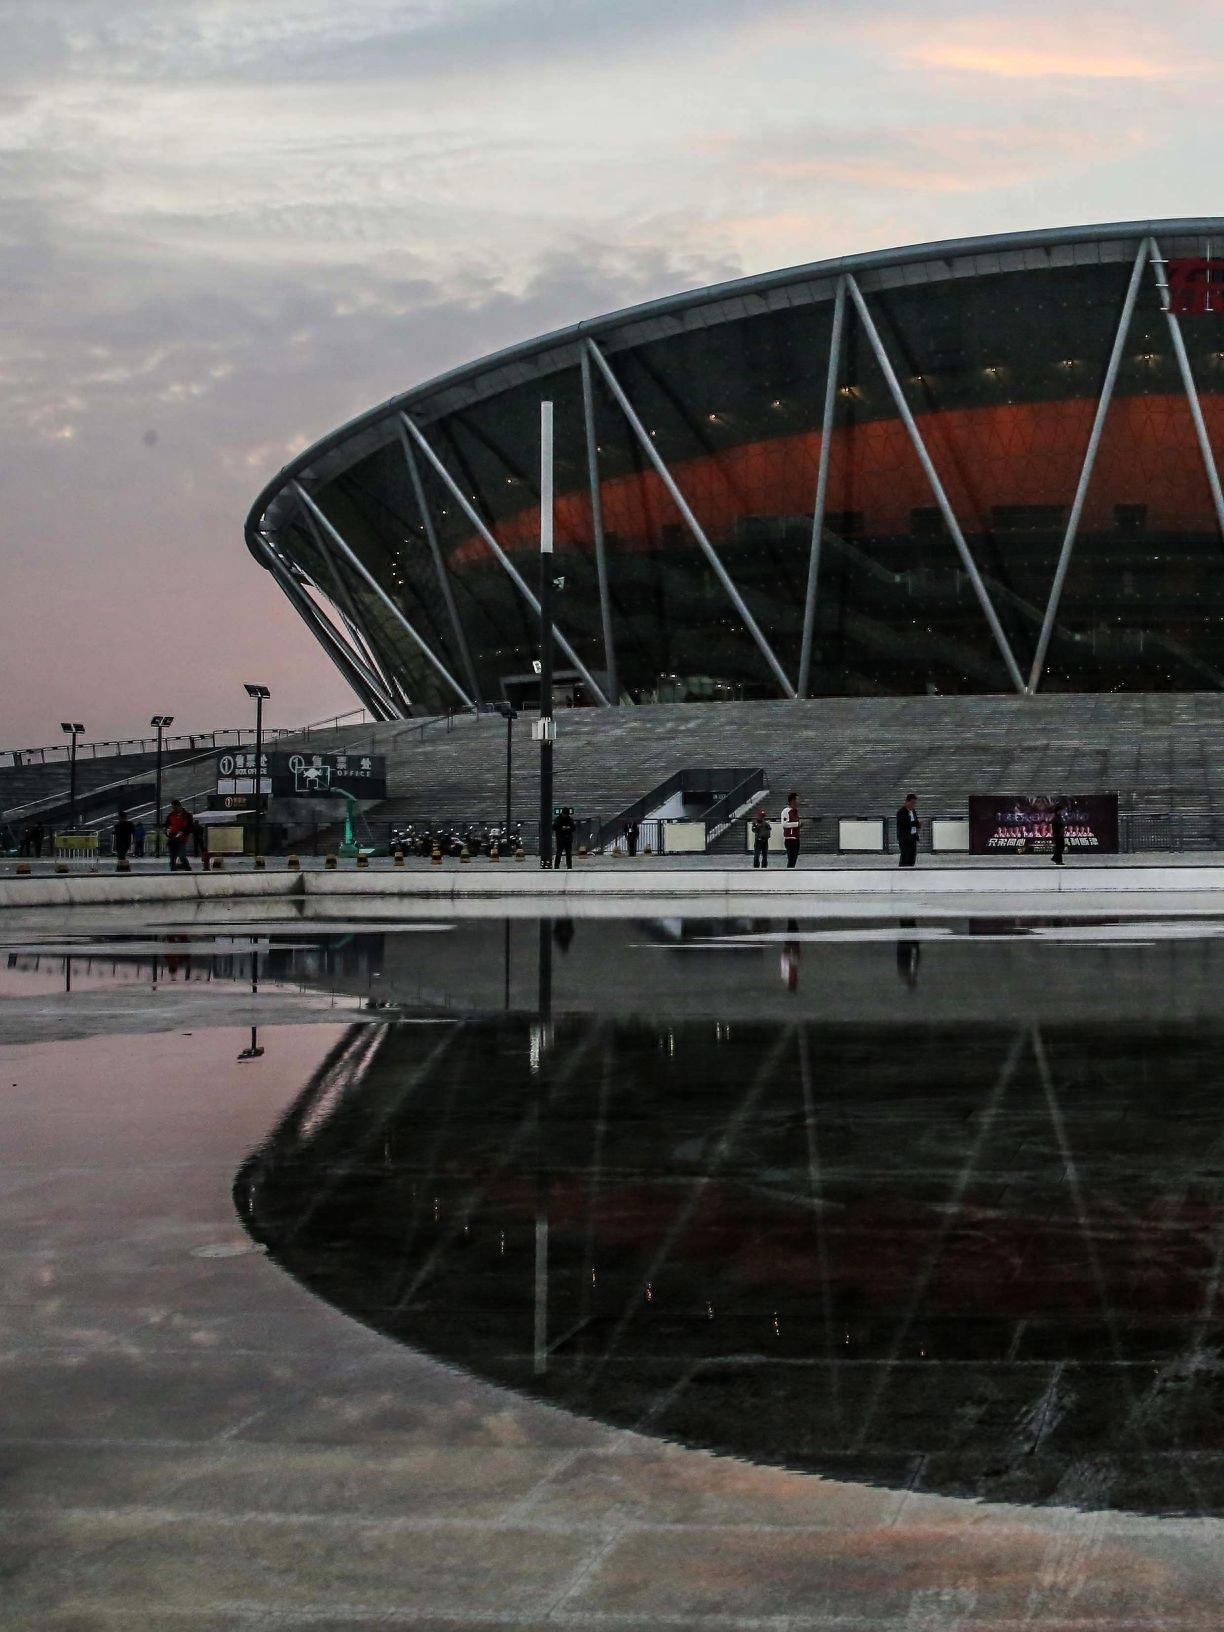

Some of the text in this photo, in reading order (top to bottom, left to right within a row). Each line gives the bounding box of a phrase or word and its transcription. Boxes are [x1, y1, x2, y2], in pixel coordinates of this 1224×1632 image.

[337, 770, 371, 778] OFFICE
[988, 837, 1026, 847] 兄弟同心
